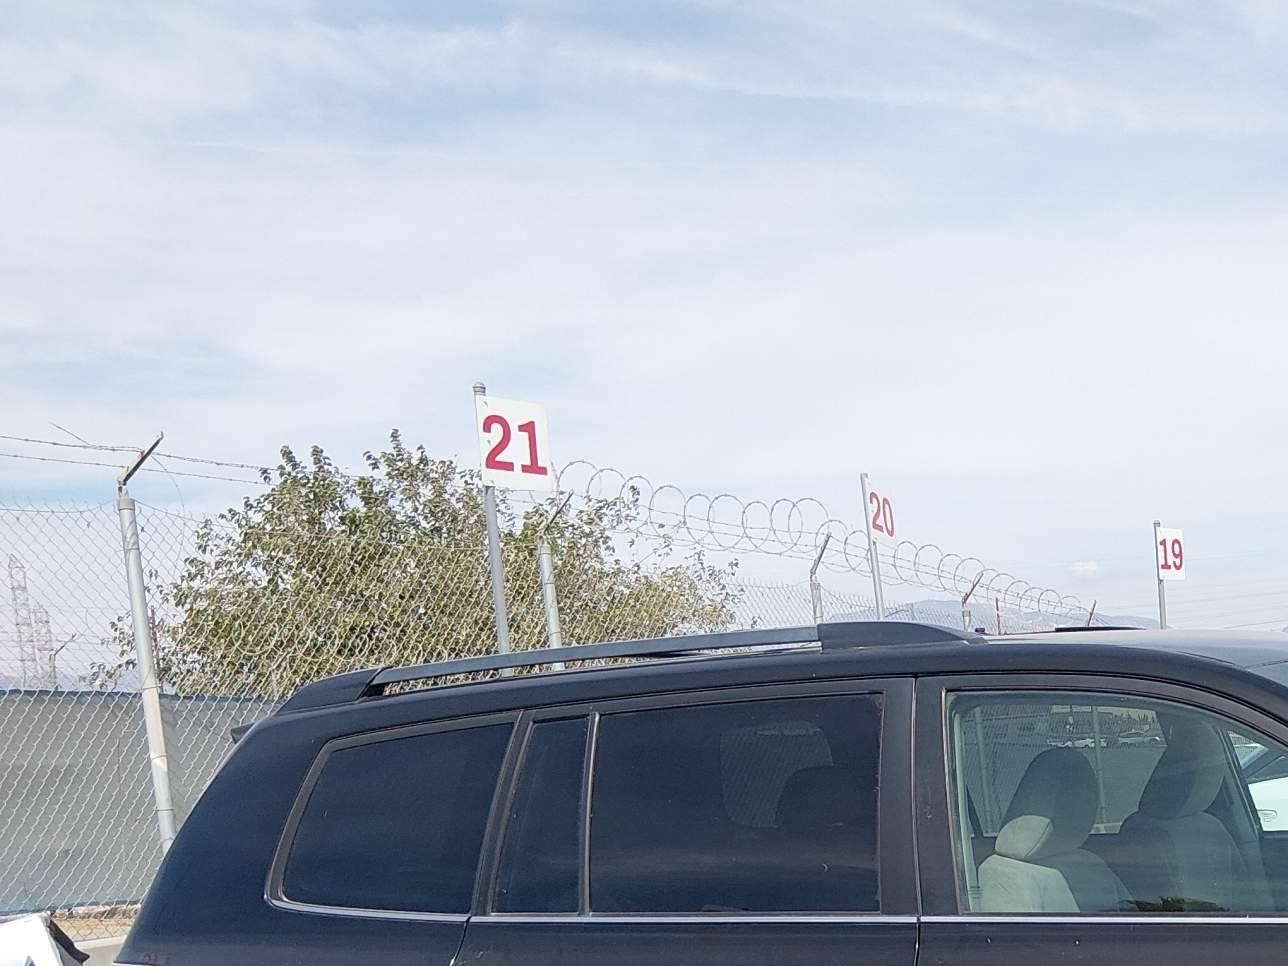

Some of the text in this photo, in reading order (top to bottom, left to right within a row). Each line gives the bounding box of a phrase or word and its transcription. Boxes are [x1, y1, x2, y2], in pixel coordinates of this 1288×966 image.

[482, 413, 549, 477] 21
[869, 491, 895, 538] 20
[1158, 538, 1184, 571] 19
